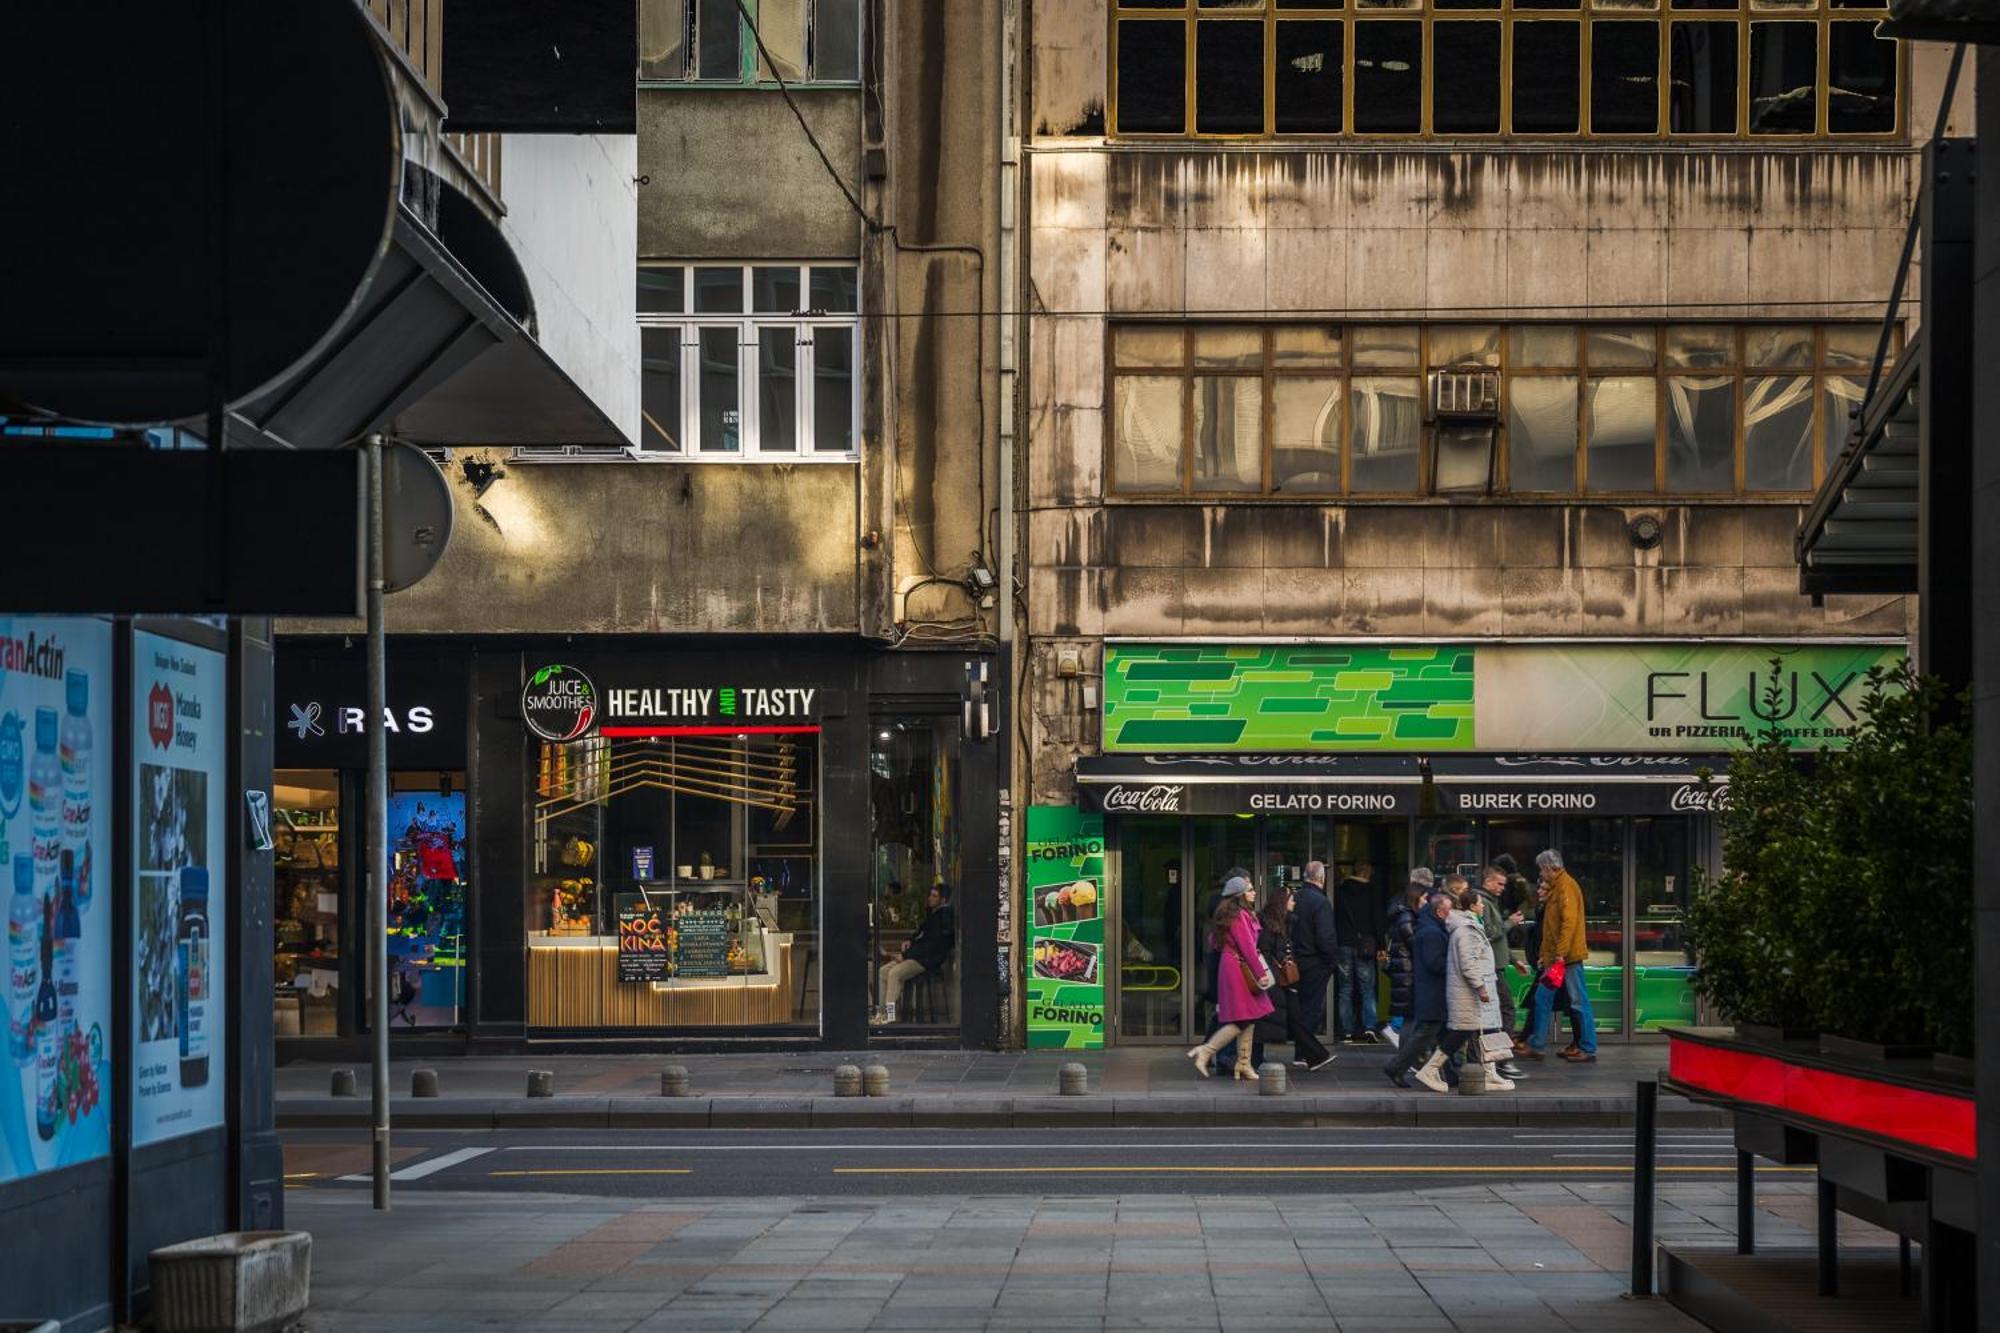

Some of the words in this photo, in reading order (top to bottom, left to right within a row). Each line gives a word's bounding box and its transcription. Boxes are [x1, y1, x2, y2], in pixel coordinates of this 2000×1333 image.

[608, 688, 712, 717] HEALTHY
[719, 687, 736, 716] AND
[742, 688, 815, 717] TASTY
[1647, 671, 1858, 721] FLUX
[176, 722, 198, 753] Honey
[1648, 726, 1672, 737] UR
[1103, 785, 1184, 811] Coca-Cola
[1250, 793, 1323, 810] GELATO
[1326, 793, 1396, 810] FORINO
[1459, 793, 1523, 809] BUREK
[1527, 793, 1596, 809] FORINO
[1031, 840, 1101, 863] FORINO
[1032, 1006, 1102, 1026] FORINO
